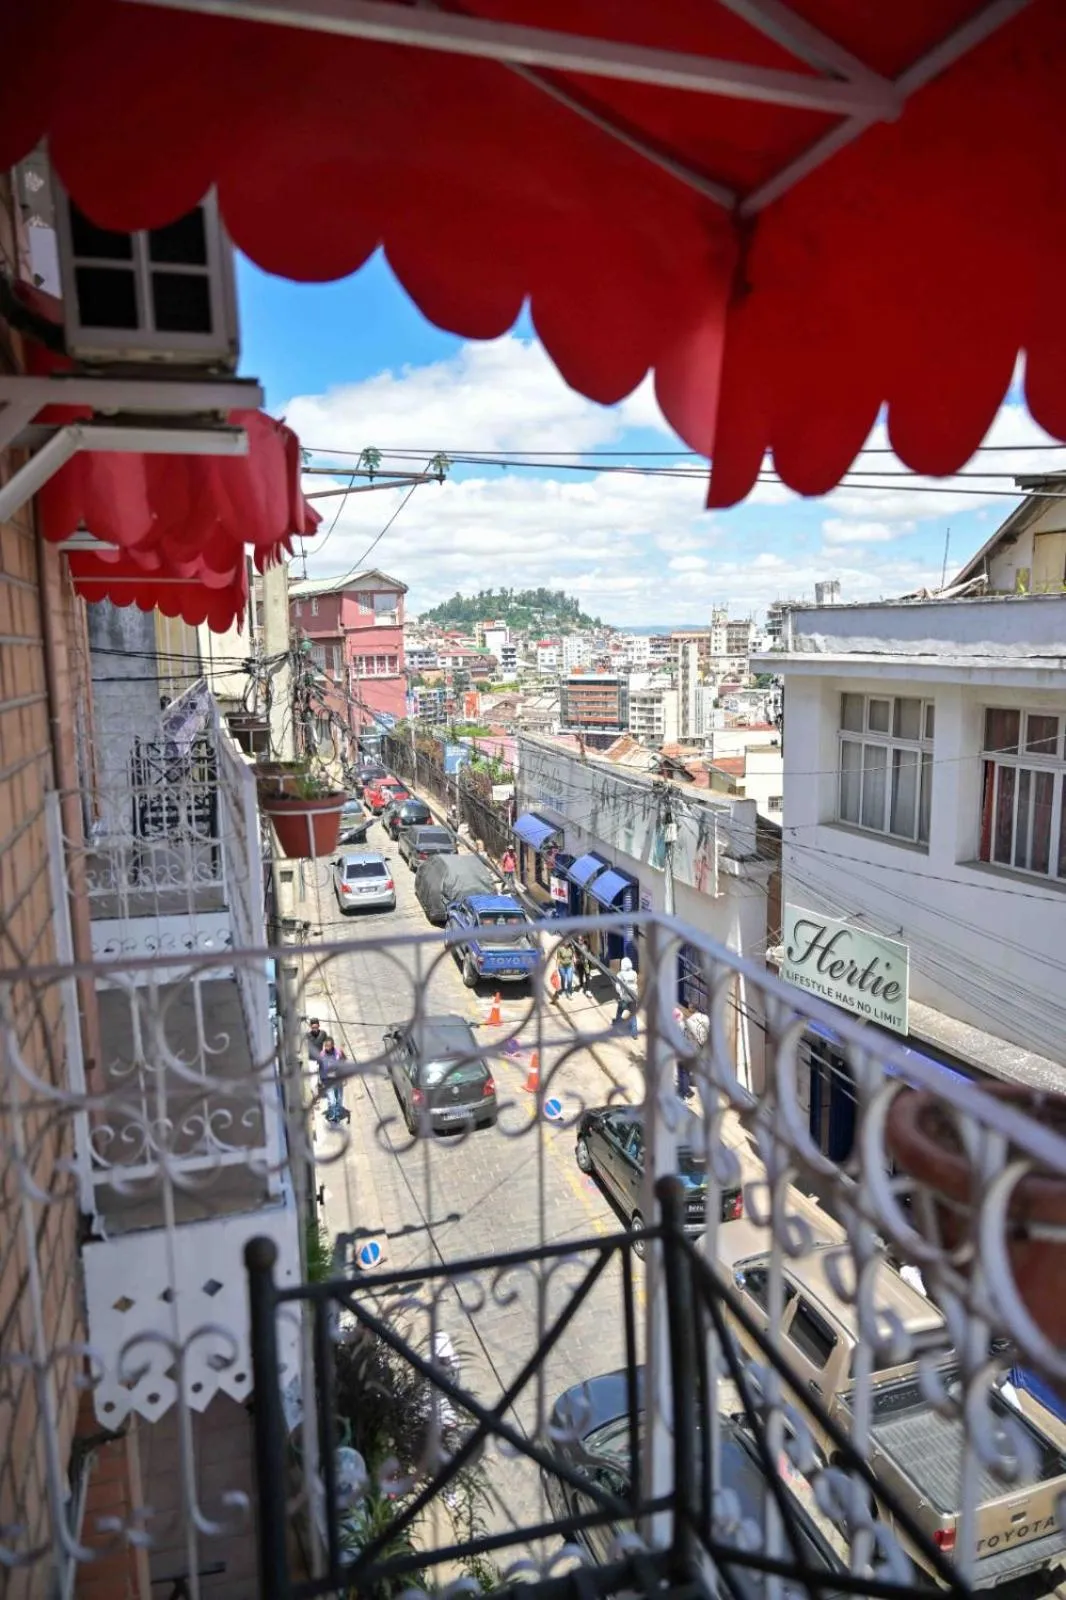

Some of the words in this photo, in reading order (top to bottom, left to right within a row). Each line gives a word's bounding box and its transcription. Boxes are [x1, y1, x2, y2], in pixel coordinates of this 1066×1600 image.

[787, 919, 902, 1002] Hertie
[786, 970, 833, 997] LIFESTYLE
[835, 992, 855, 1007] HAS
[857, 1001, 872, 1014] NO
[874, 1008, 902, 1027] LIMIT
[976, 1516, 1054, 1551] TOYOTA
